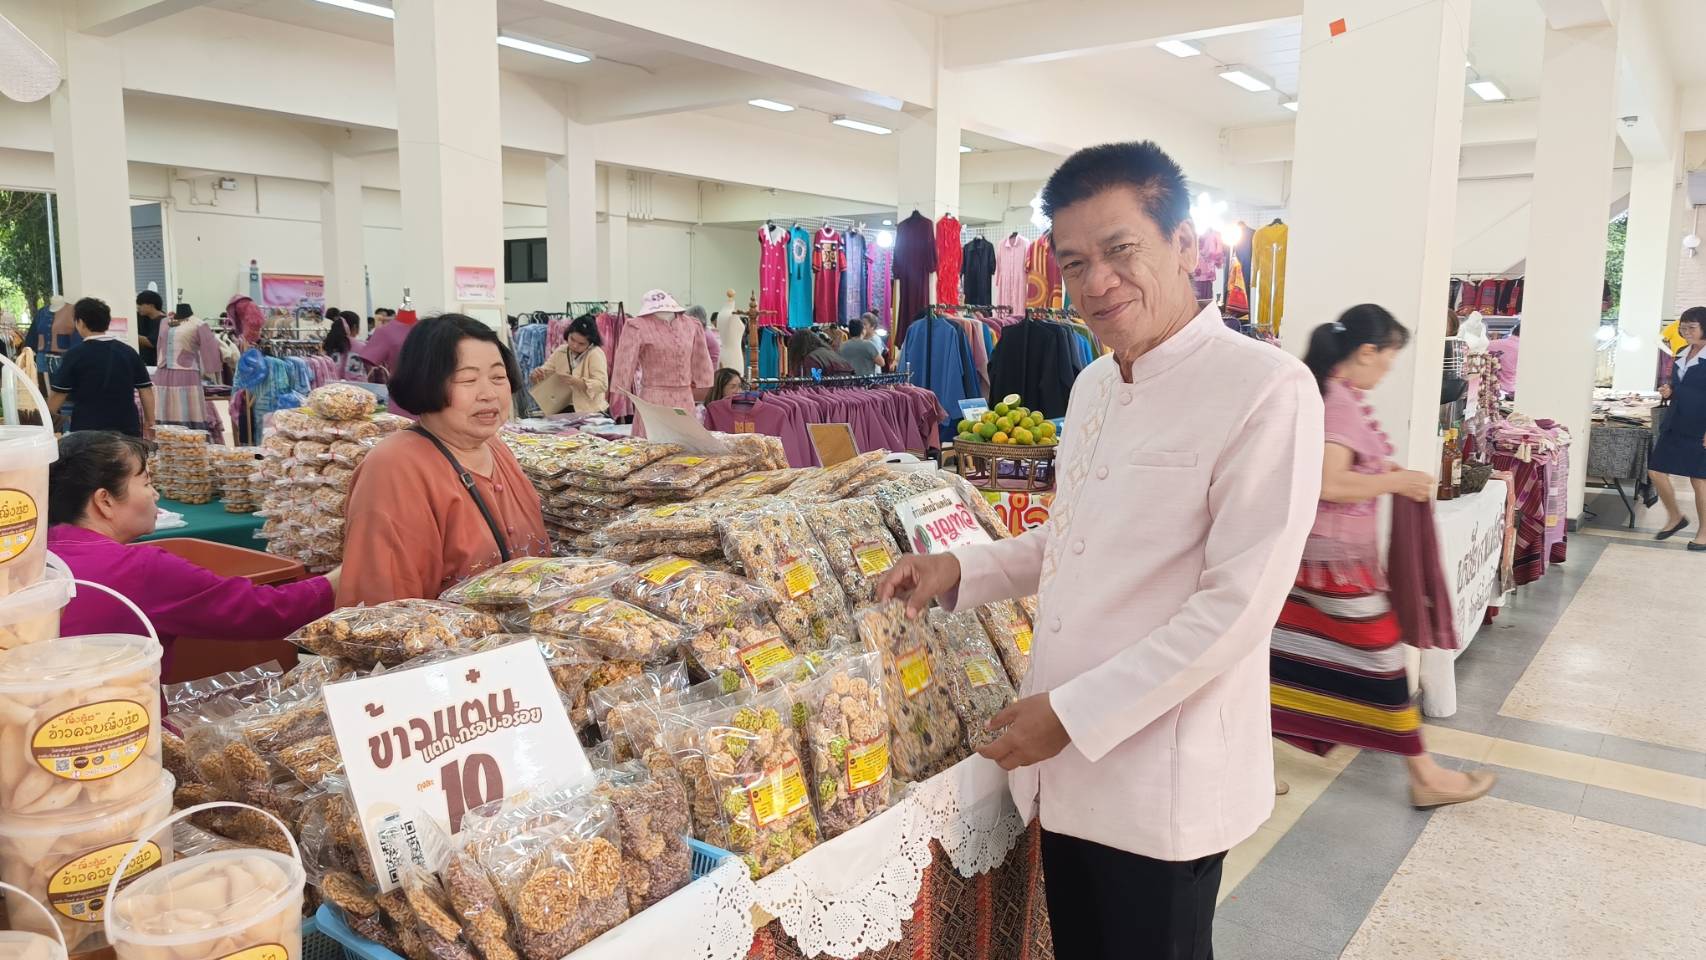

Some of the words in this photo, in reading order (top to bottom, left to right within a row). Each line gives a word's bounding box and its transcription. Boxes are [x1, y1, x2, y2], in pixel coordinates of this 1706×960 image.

[926, 502, 978, 546] บุญทวี
[365, 669, 515, 769] ข้าวแต๋น
[441, 753, 504, 835] 10
